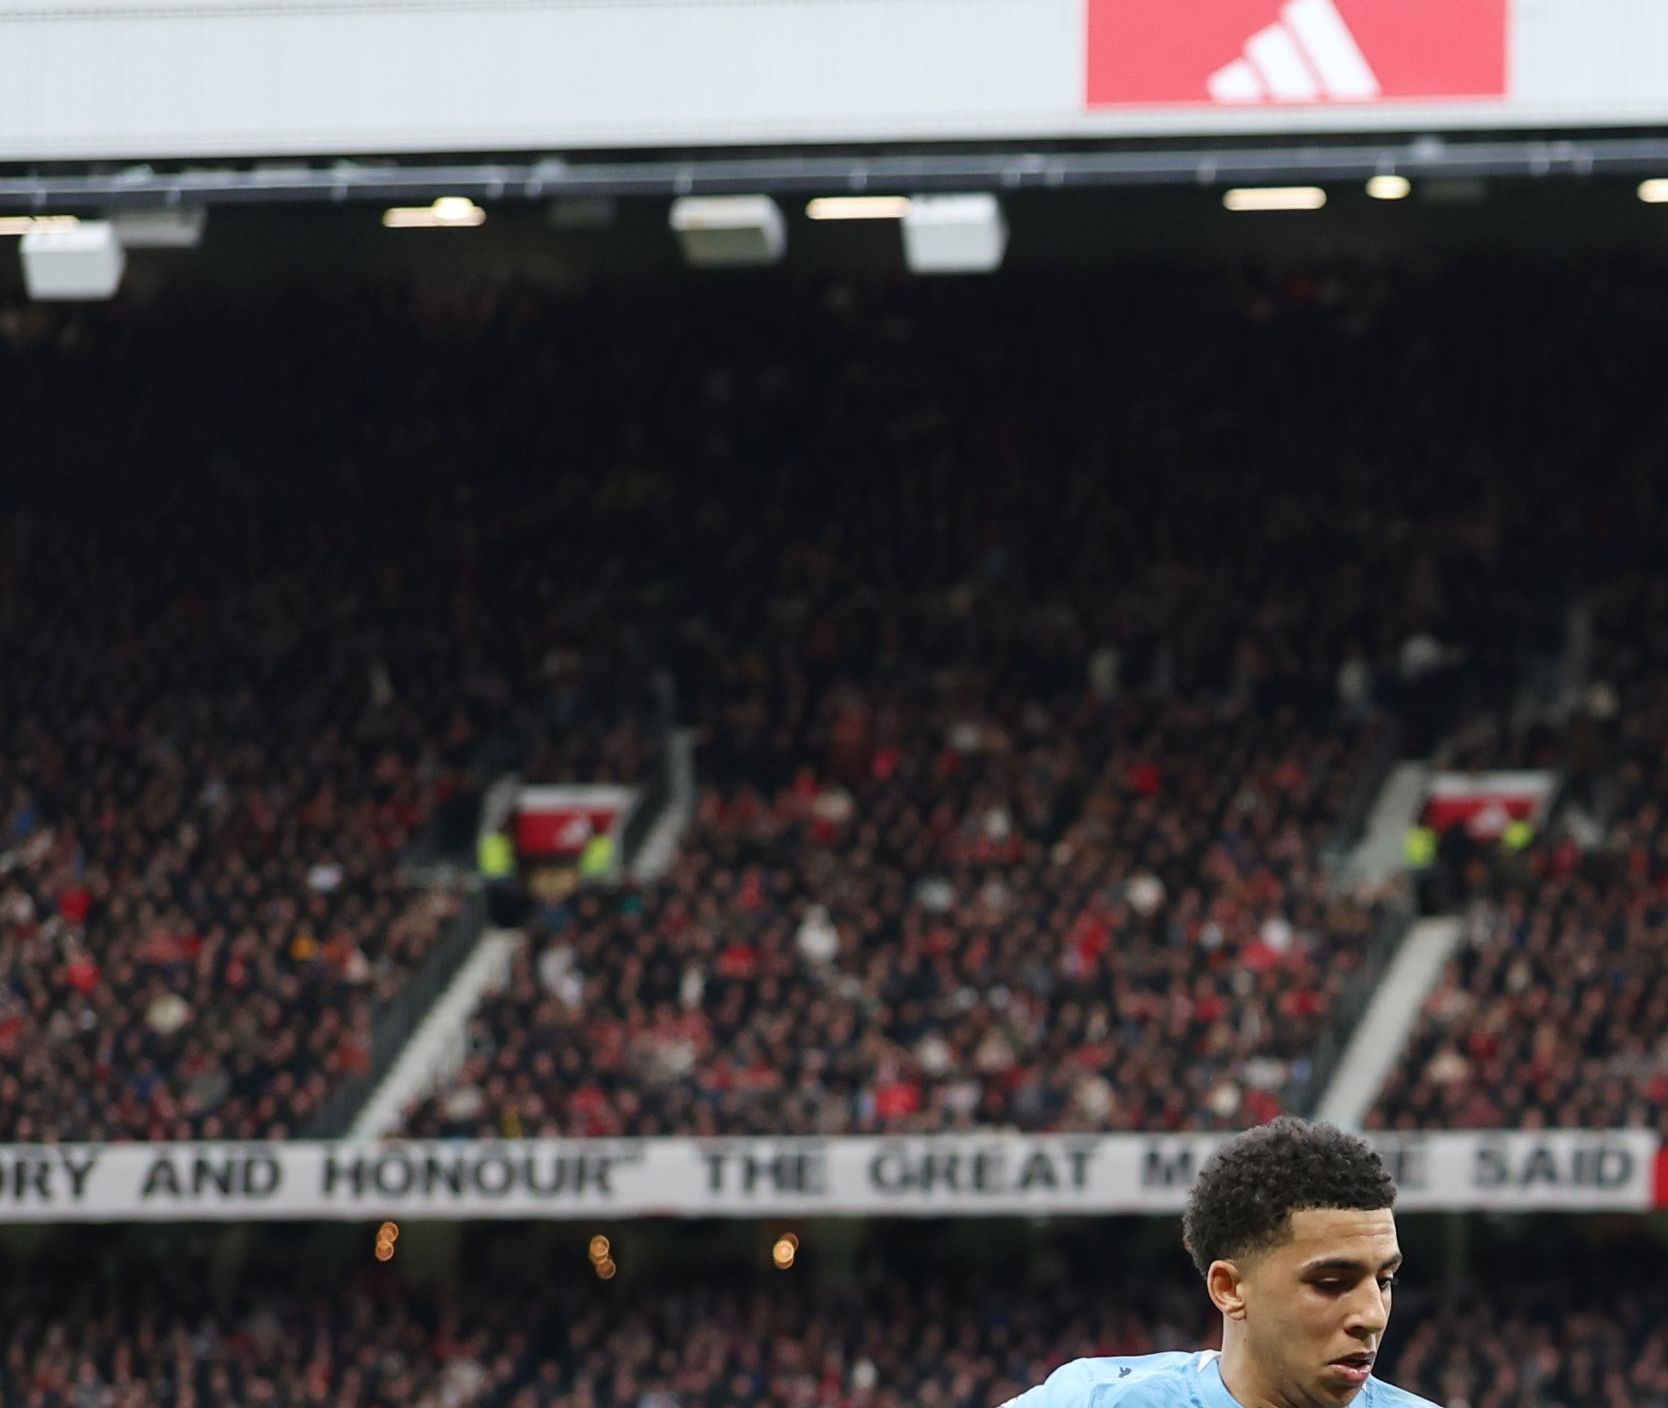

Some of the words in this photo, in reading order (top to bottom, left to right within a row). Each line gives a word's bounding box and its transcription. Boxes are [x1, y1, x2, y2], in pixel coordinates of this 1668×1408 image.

[0, 1149, 95, 1199] RY
[140, 1149, 283, 1199] AND
[704, 1146, 824, 1196] THE
[867, 1144, 1098, 1195] GREAT
[1471, 1140, 1636, 1188] SAID
